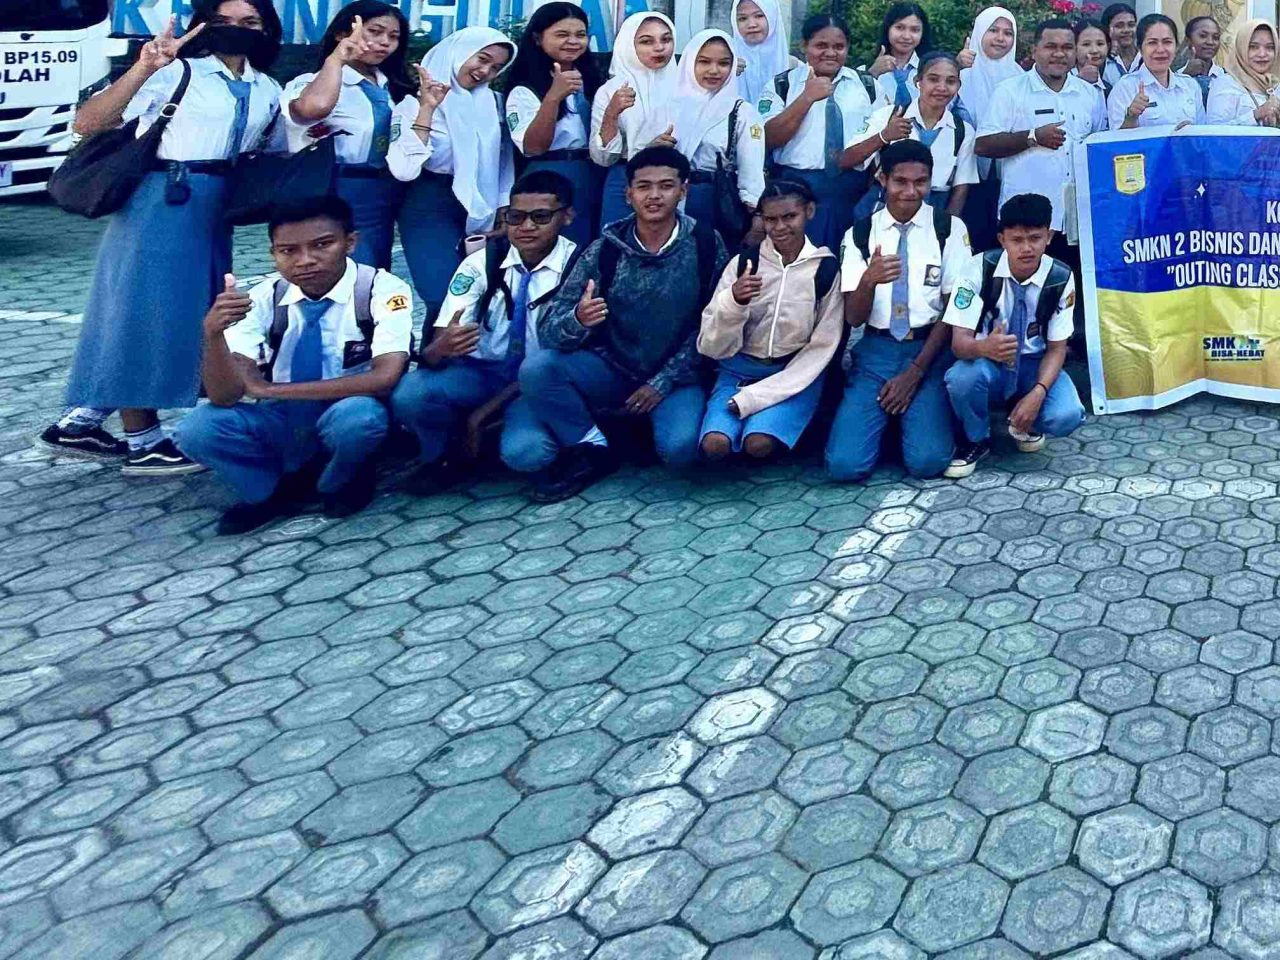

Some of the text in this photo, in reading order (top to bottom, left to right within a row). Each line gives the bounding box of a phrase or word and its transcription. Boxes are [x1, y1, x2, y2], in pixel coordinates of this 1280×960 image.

[4, 50, 78, 64] BP15.09
[0, 67, 50, 83] LAH
[1122, 234, 1172, 264] SMKN
[1175, 232, 1185, 255] 2
[1189, 230, 1245, 255] BISNIS
[1203, 336, 1236, 350] SMK
